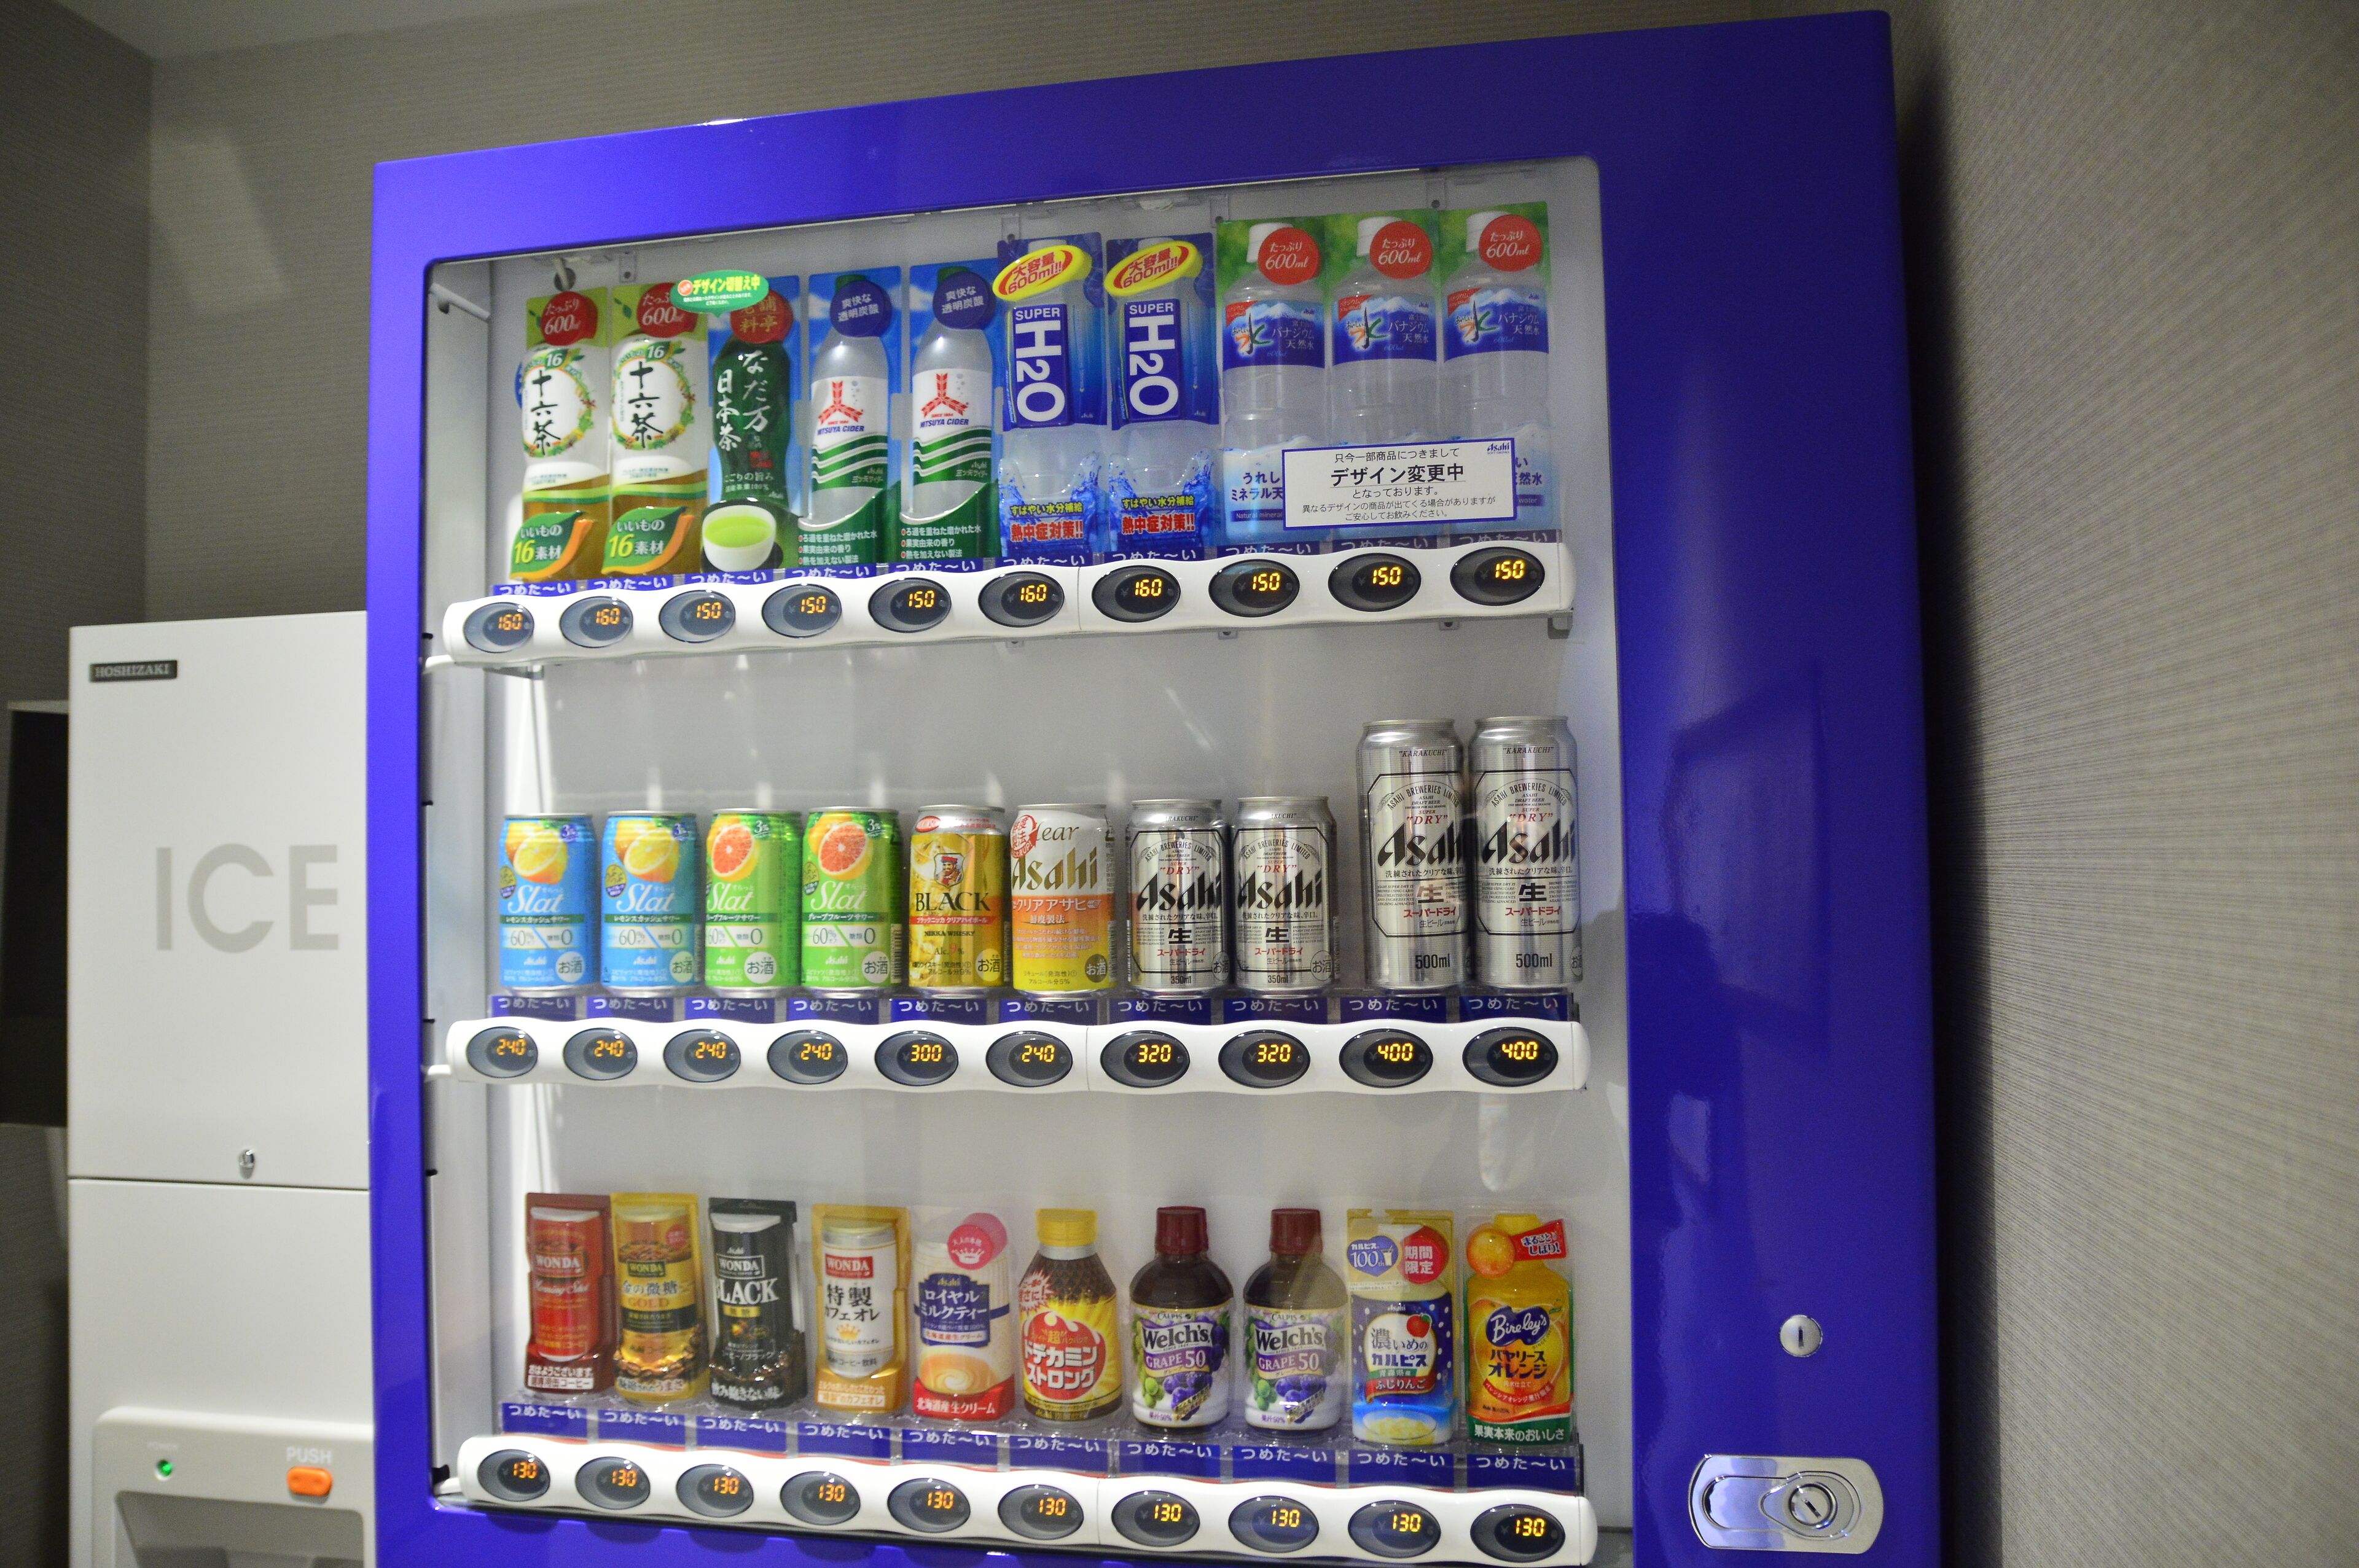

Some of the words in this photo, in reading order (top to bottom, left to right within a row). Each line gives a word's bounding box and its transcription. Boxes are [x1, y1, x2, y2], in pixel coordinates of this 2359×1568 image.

[1382, 238, 1415, 249] たっぷり
[1490, 230, 1524, 242] たっぷり
[1270, 241, 1302, 253] たっぷり
[1486, 242, 1530, 258] 600ml
[1014, 252, 1055, 277] 大容量
[1129, 248, 1169, 274] 大容量
[1266, 253, 1308, 270] 600ml
[1378, 248, 1421, 265] 600ml
[842, 294, 871, 308] 爽快な
[946, 286, 976, 301] 爽快な
[546, 299, 580, 316] たっぷり
[838, 305, 879, 322] 透明炭酸
[942, 297, 984, 314] 透明炭酸
[1015, 307, 1060, 321] SUPER
[1129, 302, 1174, 316] SUPER
[1388, 321, 1429, 333] バナジウム
[1498, 313, 1539, 324] バナジウム
[1272, 327, 1314, 340] バナジウム
[1402, 333, 1428, 343] 天然水
[1514, 325, 1539, 335] 天然水
[647, 344, 665, 359] 16
[1286, 339, 1314, 349] 天然水
[546, 353, 563, 367] 16
[1129, 314, 1178, 415] H2O
[1015, 320, 1065, 422] H2O
[531, 370, 561, 455] 十六茶
[628, 361, 663, 448] 十六茶
[716, 369, 741, 451] 日本茶
[1335, 448, 1460, 463] 只今一部商品につきまして
[1487, 443, 1509, 451] Asahi
[1331, 464, 1464, 486] デザイン変更中
[1353, 486, 1439, 499] となっております。
[1011, 501, 1082, 516] すばやい水分補給
[1122, 496, 1194, 509] すばやい水分補給
[1302, 496, 1495, 513] 異なるデザインの商品が出てくる場合がありますが
[1122, 513, 1195, 535] 熱中症対策!!
[1345, 510, 1448, 521] ご安心してお飲みください。
[520, 526, 562, 538] いいもの
[617, 520, 665, 532] いいもの
[1011, 521, 1083, 542] 熱中症対策!!
[1373, 567, 1401, 585] 150
[1495, 560, 1525, 579] 150
[1135, 579, 1162, 596] 160
[1253, 573, 1280, 591] 150
[909, 590, 934, 607] 150
[1021, 585, 1046, 602] 160
[697, 602, 721, 619] 150
[801, 596, 826, 614] 150
[499, 614, 522, 630] 160
[597, 608, 620, 625] 160
[95, 663, 170, 678] HOSHIZAKI
[1387, 793, 1404, 810] ASAHI
[1406, 785, 1441, 797] BREWERIES
[1492, 790, 1508, 807] ASAHI
[1509, 782, 1546, 794] BREWERIES
[1549, 787, 1567, 806] LIMITED
[1258, 839, 1289, 849] BREWERIES
[1291, 843, 1310, 860] LIMITED
[1482, 818, 1576, 864] Asahi
[1160, 841, 1192, 851] BREWERIES
[1194, 845, 1212, 862] LIMITED
[1012, 846, 1098, 890] Asahi
[810, 881, 868, 910] Slat
[1136, 871, 1221, 911] Asahi
[1237, 867, 1322, 909] Asahi
[1416, 884, 1444, 903] 生
[1518, 883, 1547, 902] 生
[156, 843, 339, 953] ICE
[507, 885, 565, 913] Slat
[616, 883, 676, 912] Slat
[915, 892, 991, 911] BLACK
[1403, 907, 1456, 918] スーパードライ
[1505, 906, 1561, 916] スーパードライ
[1168, 927, 1192, 944] 生
[1266, 926, 1289, 943] 生
[558, 960, 582, 974] お酒
[672, 960, 692, 974] お酒
[747, 961, 774, 975] お酒
[864, 961, 889, 975] お酒
[978, 958, 1000, 972] お酒
[1415, 954, 1450, 969] 500ml
[1516, 954, 1552, 968] 500ml
[1267, 975, 1289, 983] 350ml
[497, 1039, 526, 1055] 240
[595, 1040, 624, 1057] 240
[695, 1042, 726, 1058] 240
[801, 1043, 832, 1060] 240
[911, 1045, 942, 1061] 300
[1022, 1045, 1054, 1062] 240
[1139, 1044, 1171, 1063] 320
[1258, 1044, 1291, 1062] 320
[1378, 1043, 1413, 1061] 400
[1502, 1042, 1538, 1059] 400
[1405, 1246, 1433, 1259] 期間
[536, 1256, 579, 1268] WONDA
[630, 1263, 663, 1273] WONDA
[720, 1260, 759, 1271] WONDA
[827, 1257, 869, 1271] WONDA
[1405, 1261, 1434, 1274] 限定
[622, 1281, 679, 1295] 金の微糖
[827, 1284, 872, 1307] 特製
[925, 1290, 979, 1304] ロイヤル
[825, 1306, 880, 1322] カフェオレ
[920, 1305, 987, 1320] ミルクティー
[1490, 1313, 1547, 1343] Bireley's
[1371, 1327, 1428, 1351] 濃いめの
[1025, 1339, 1097, 1368] ドデカミン
[1146, 1354, 1183, 1368] GRAPE
[1185, 1351, 1205, 1368] 50
[1259, 1357, 1295, 1370] GRAPE
[1298, 1353, 1319, 1370] 50
[1372, 1353, 1428, 1367] カルピス
[1490, 1349, 1546, 1362] バヤリース
[1027, 1365, 1094, 1390] ストロング
[1488, 1362, 1547, 1379] オレンジ
[1376, 1378, 1425, 1389] ふじりんご
[1474, 1424, 1565, 1442] 果実本来のおいしさ
[286, 1446, 332, 1464] PUSH
[514, 1462, 537, 1478] 130
[612, 1469, 636, 1486] 130
[714, 1477, 739, 1494] 130
[820, 1484, 845, 1502] 130
[928, 1491, 953, 1508] 130
[1039, 1497, 1066, 1516] 130
[1155, 1504, 1181, 1521] 130
[1273, 1509, 1300, 1527] 130
[1393, 1513, 1421, 1532] 130
[1516, 1518, 1545, 1536] 130
